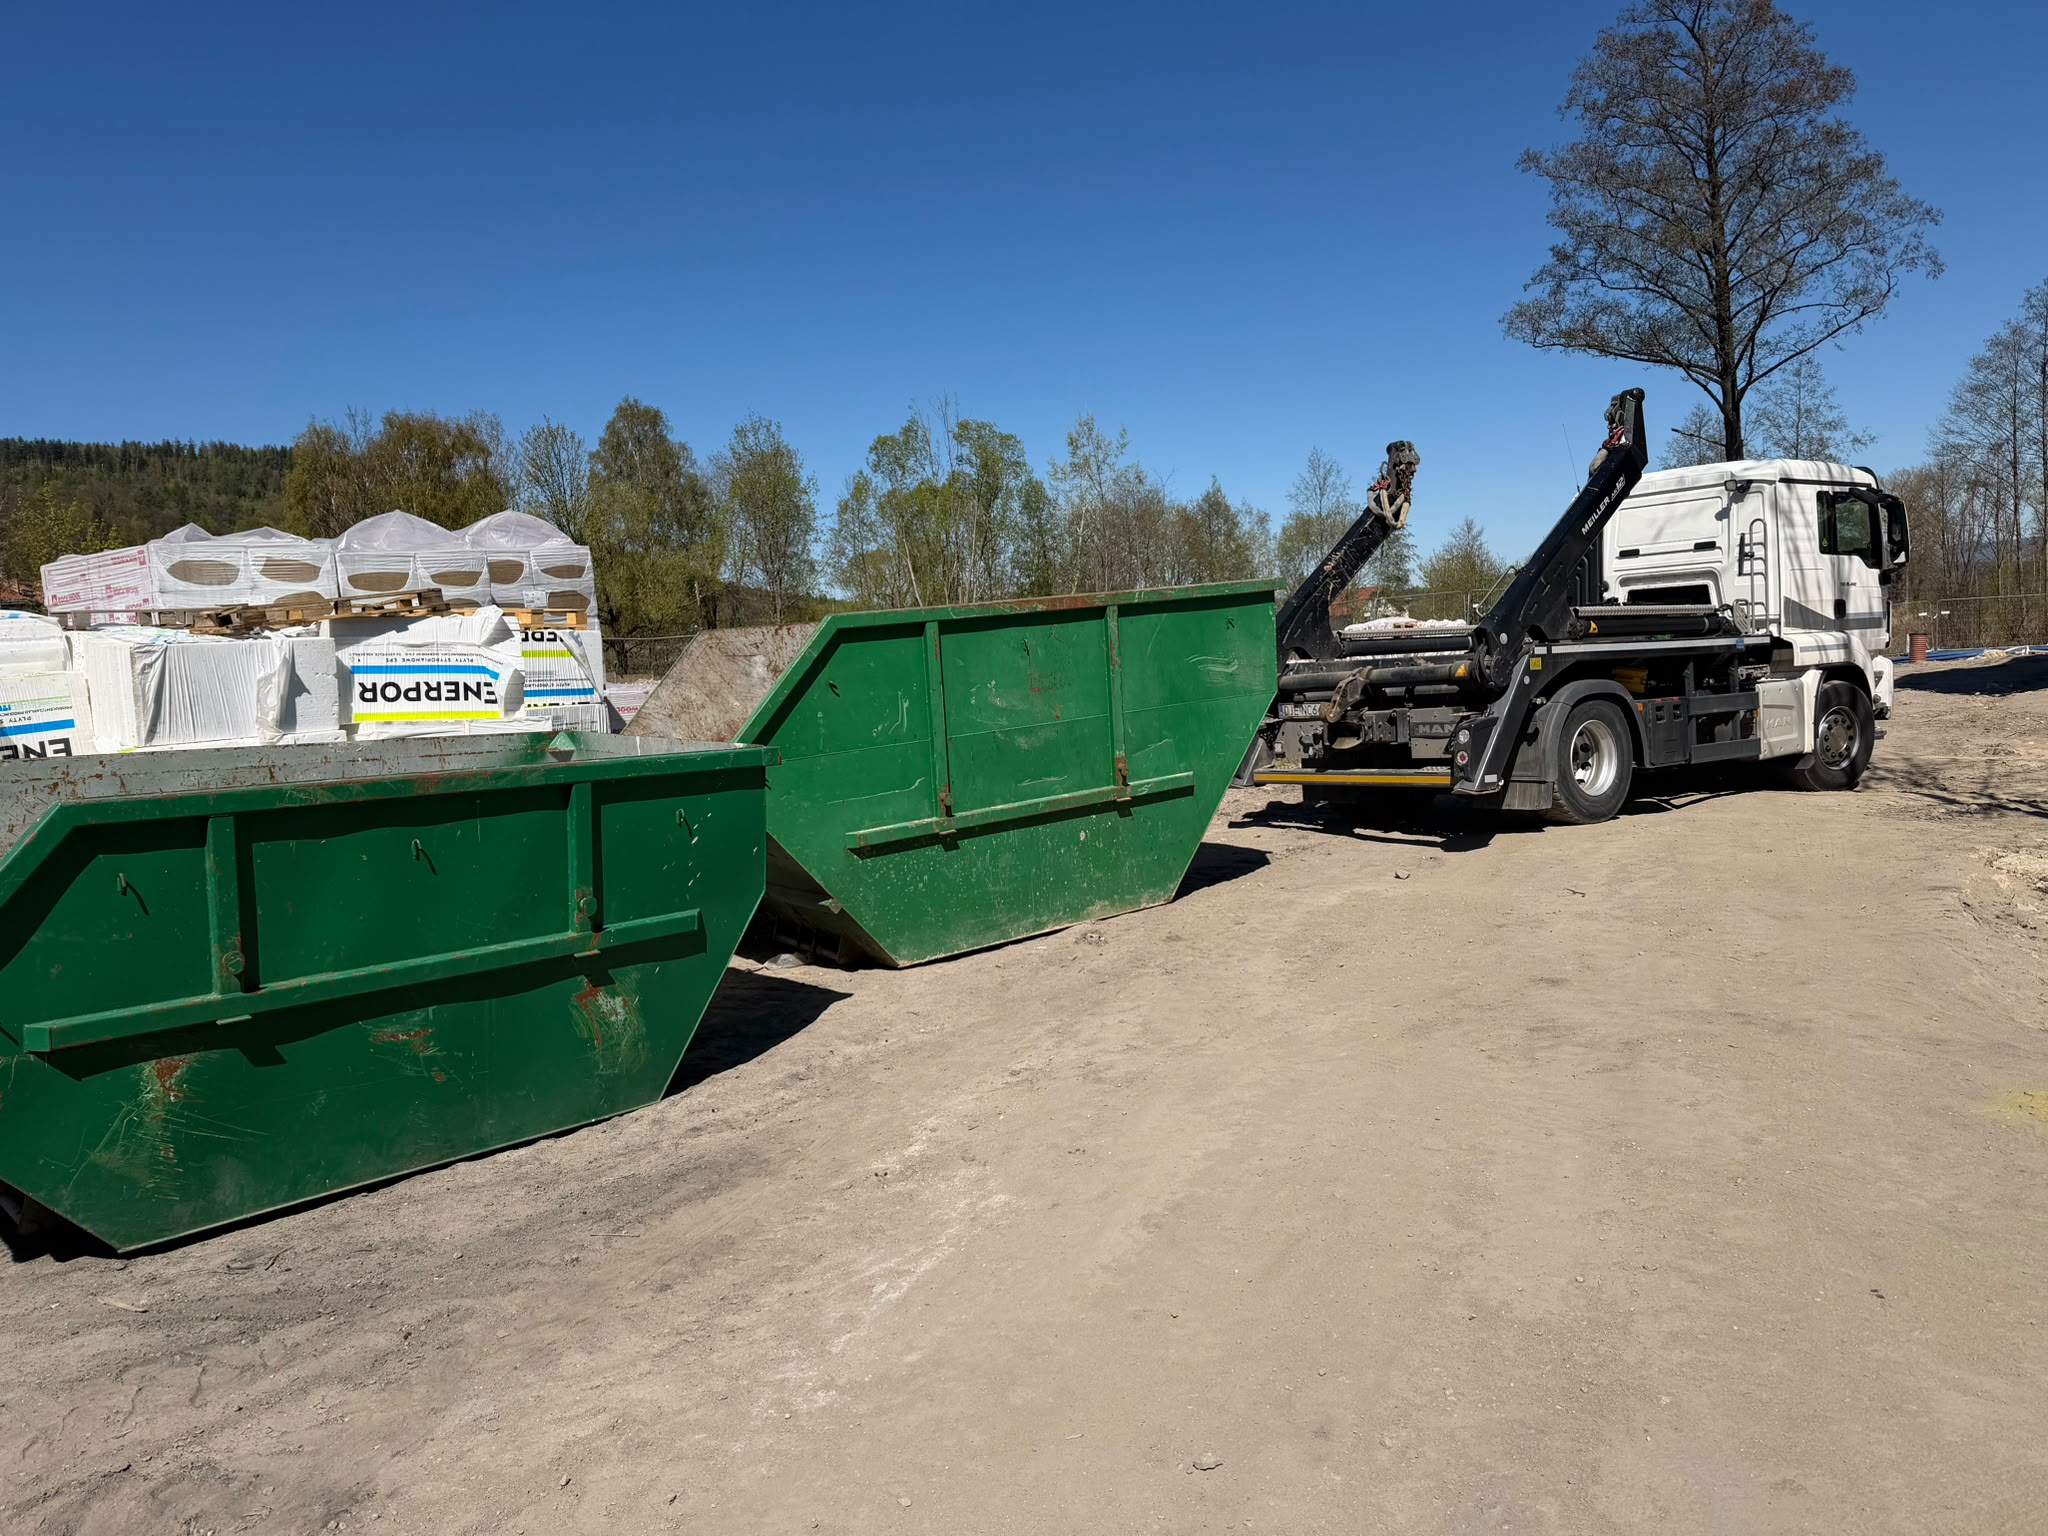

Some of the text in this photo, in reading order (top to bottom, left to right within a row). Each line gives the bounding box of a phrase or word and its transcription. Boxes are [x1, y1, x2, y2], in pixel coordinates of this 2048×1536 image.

[1581, 496, 1610, 535] MEILLER
[358, 681, 498, 704] ENERPOR
[1418, 724, 1456, 734] MAN
[1766, 716, 1792, 729] MAN
